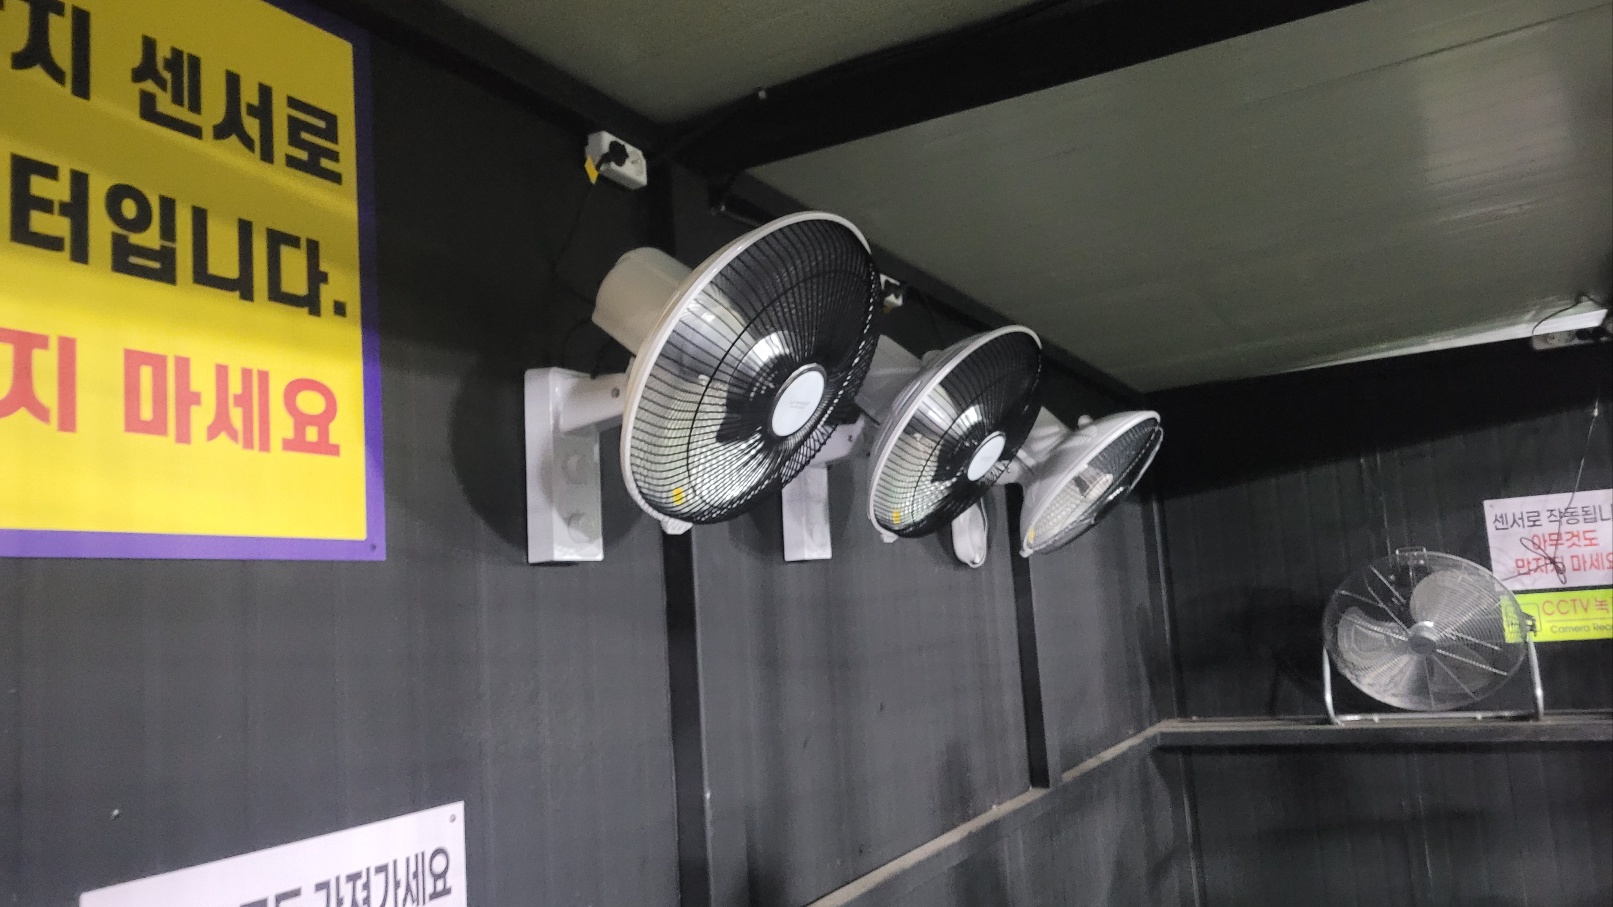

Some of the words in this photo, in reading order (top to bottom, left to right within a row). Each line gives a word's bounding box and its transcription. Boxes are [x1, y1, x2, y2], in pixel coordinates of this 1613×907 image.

[0, 0, 91, 101] 지
[132, 35, 343, 186] 센서로
[10, 154, 348, 317] 터입니다.
[123, 348, 341, 457] 마세요
[1493, 511, 1543, 531] 센서로
[1532, 530, 1599, 550] 아무것도
[1542, 599, 1589, 616] CCTV
[1551, 623, 1590, 634] Camera
